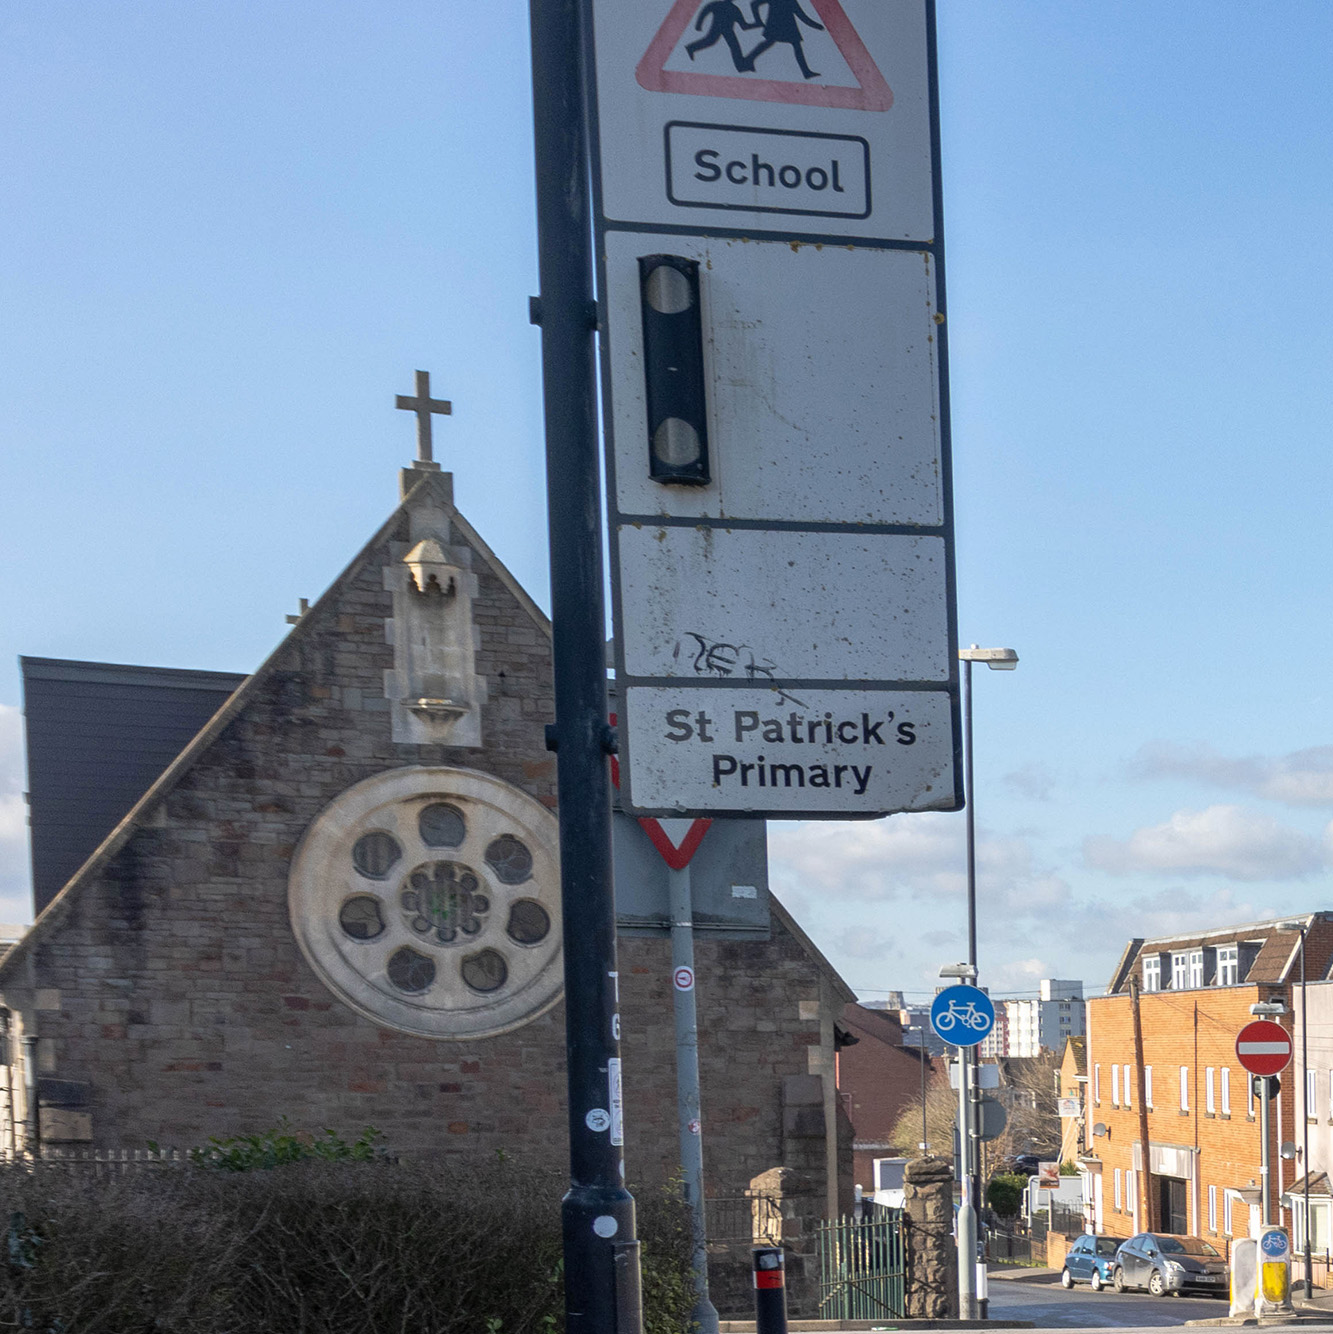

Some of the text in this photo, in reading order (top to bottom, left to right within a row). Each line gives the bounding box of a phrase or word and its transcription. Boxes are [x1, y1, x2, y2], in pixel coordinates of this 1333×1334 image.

[694, 149, 845, 193] School
[664, 709, 917, 746] St Patrick's
[711, 754, 873, 795] Primary
